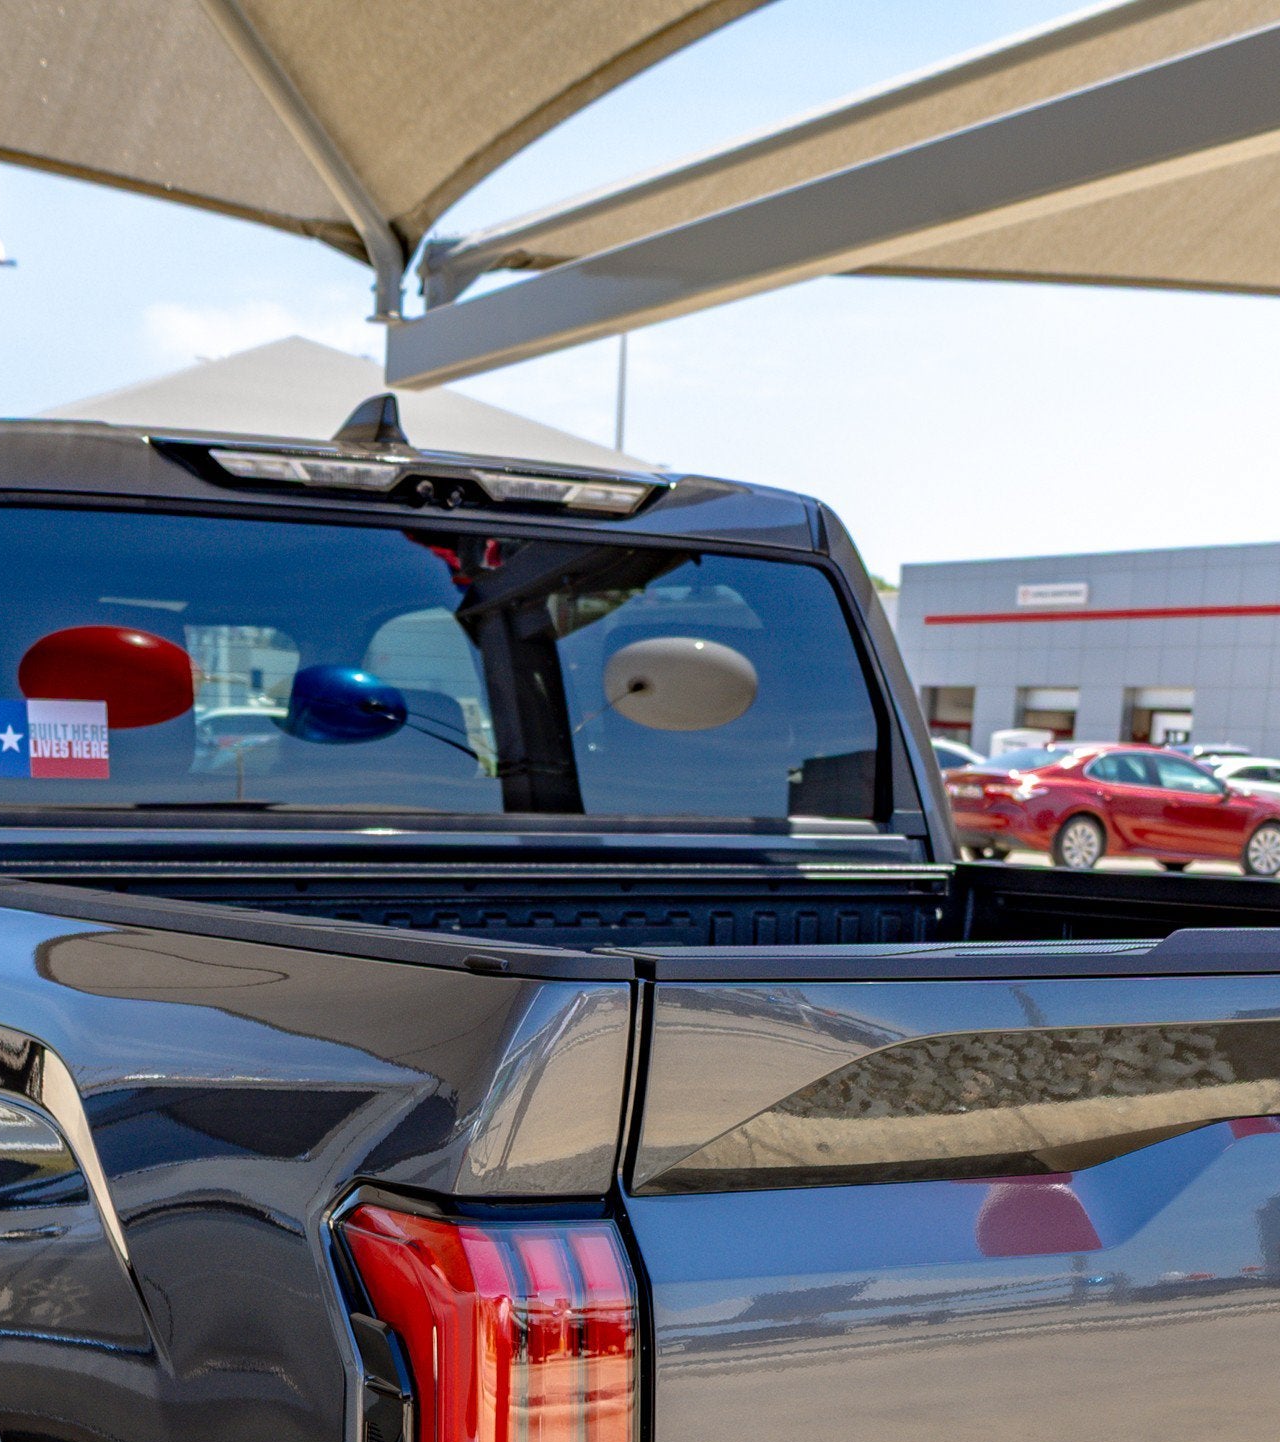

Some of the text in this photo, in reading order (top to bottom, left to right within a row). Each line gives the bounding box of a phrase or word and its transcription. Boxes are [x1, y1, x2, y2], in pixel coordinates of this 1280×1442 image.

[29, 723, 108, 741] BUILT HERE
[30, 740, 110, 759] LIVES HERE
